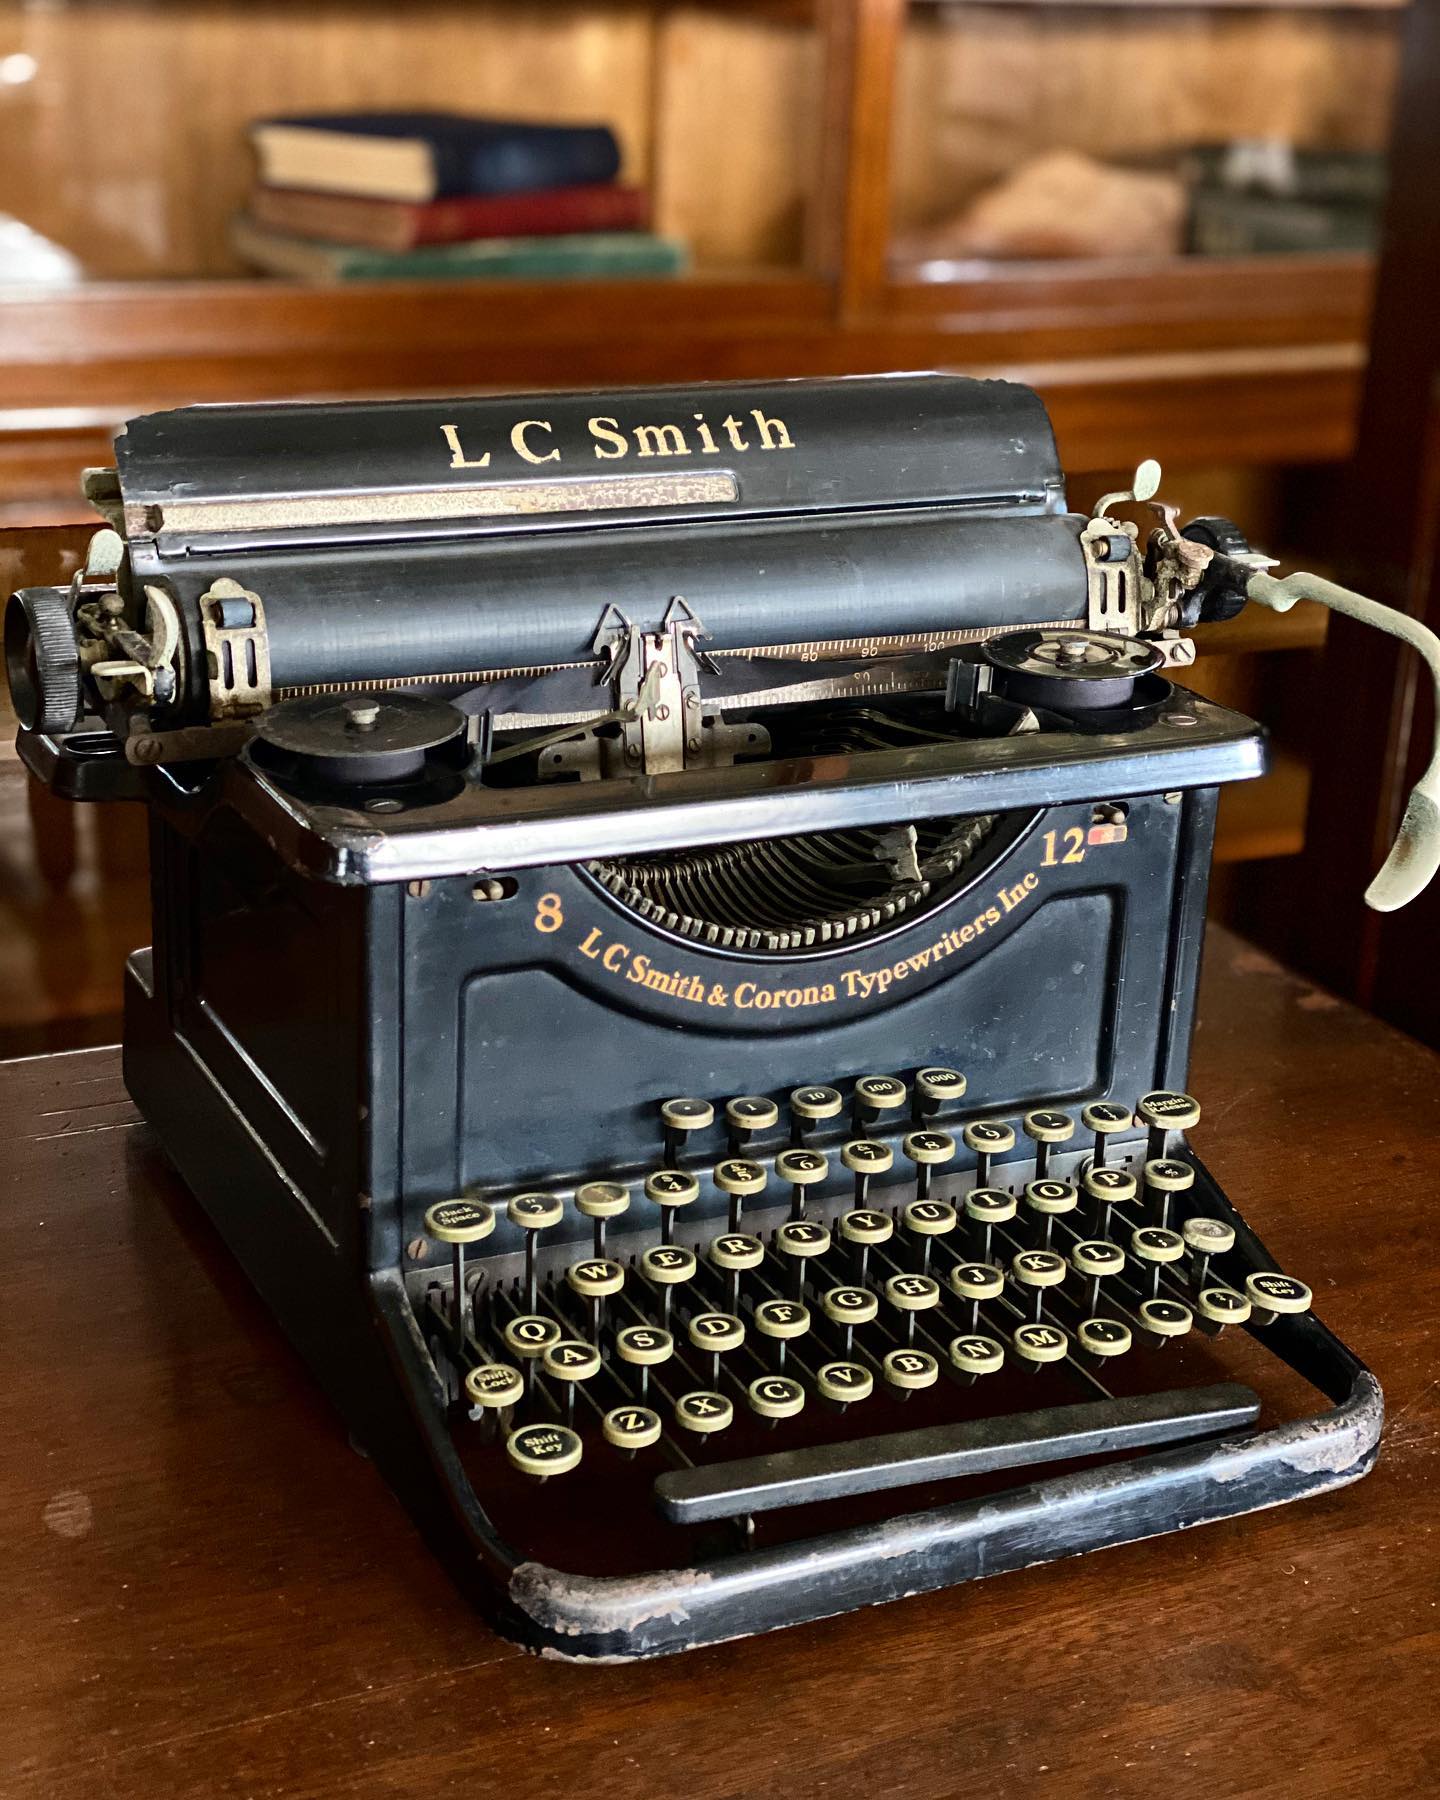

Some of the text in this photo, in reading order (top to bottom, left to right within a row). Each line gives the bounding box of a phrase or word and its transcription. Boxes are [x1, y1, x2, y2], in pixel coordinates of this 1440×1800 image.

[440, 409, 796, 468] L C Smith
[861, 646, 878, 658] 90
[1040, 826, 1086, 867] 12
[534, 893, 564, 933] 8
[578, 871, 1039, 1010] L C Smith & Corona Typewriters Inc
[926, 1073, 957, 1084] 1000
[867, 1082, 893, 1092] 100
[808, 1091, 826, 1101] 10
[1144, 1097, 1185, 1107] Margin
[1150, 1102, 1192, 1113] Release
[986, 1130, 1000, 1139] 9
[925, 1141, 940, 1150] 8
[864, 1151, 875, 1159] 7
[800, 1160, 814, 1170] 6
[736, 1170, 752, 1181] 5
[1098, 1173, 1120, 1186] P
[668, 1181, 682, 1191] 4
[1040, 1185, 1064, 1197] O
[980, 1194, 1000, 1206] I
[438, 1207, 474, 1217] Back
[530, 1204, 546, 1213] 2
[914, 1206, 940, 1218] U
[440, 1213, 480, 1224] Space
[855, 1215, 877, 1228] Y
[789, 1227, 813, 1240] T
[721, 1239, 752, 1253] R
[654, 1251, 682, 1267] E
[1084, 1247, 1111, 1260] L
[1022, 1256, 1054, 1270] K
[579, 1264, 609, 1280] W
[969, 1269, 985, 1282] J
[898, 1279, 929, 1294] H
[1260, 1280, 1291, 1289] Shift
[1268, 1286, 1295, 1295] Key
[837, 1292, 863, 1305] G
[770, 1306, 793, 1322] F
[519, 1323, 546, 1341] Q
[700, 1320, 730, 1335] D
[632, 1333, 655, 1347] S
[1024, 1330, 1058, 1346] M
[562, 1348, 588, 1364] A
[962, 1342, 991, 1357] N
[898, 1356, 924, 1371] B
[829, 1368, 853, 1382] V
[480, 1377, 514, 1389] Lock
[763, 1383, 790, 1399] C
[690, 1398, 721, 1414] X
[619, 1413, 645, 1430] Z
[523, 1433, 560, 1448] Shift
[532, 1442, 564, 1455] Key
